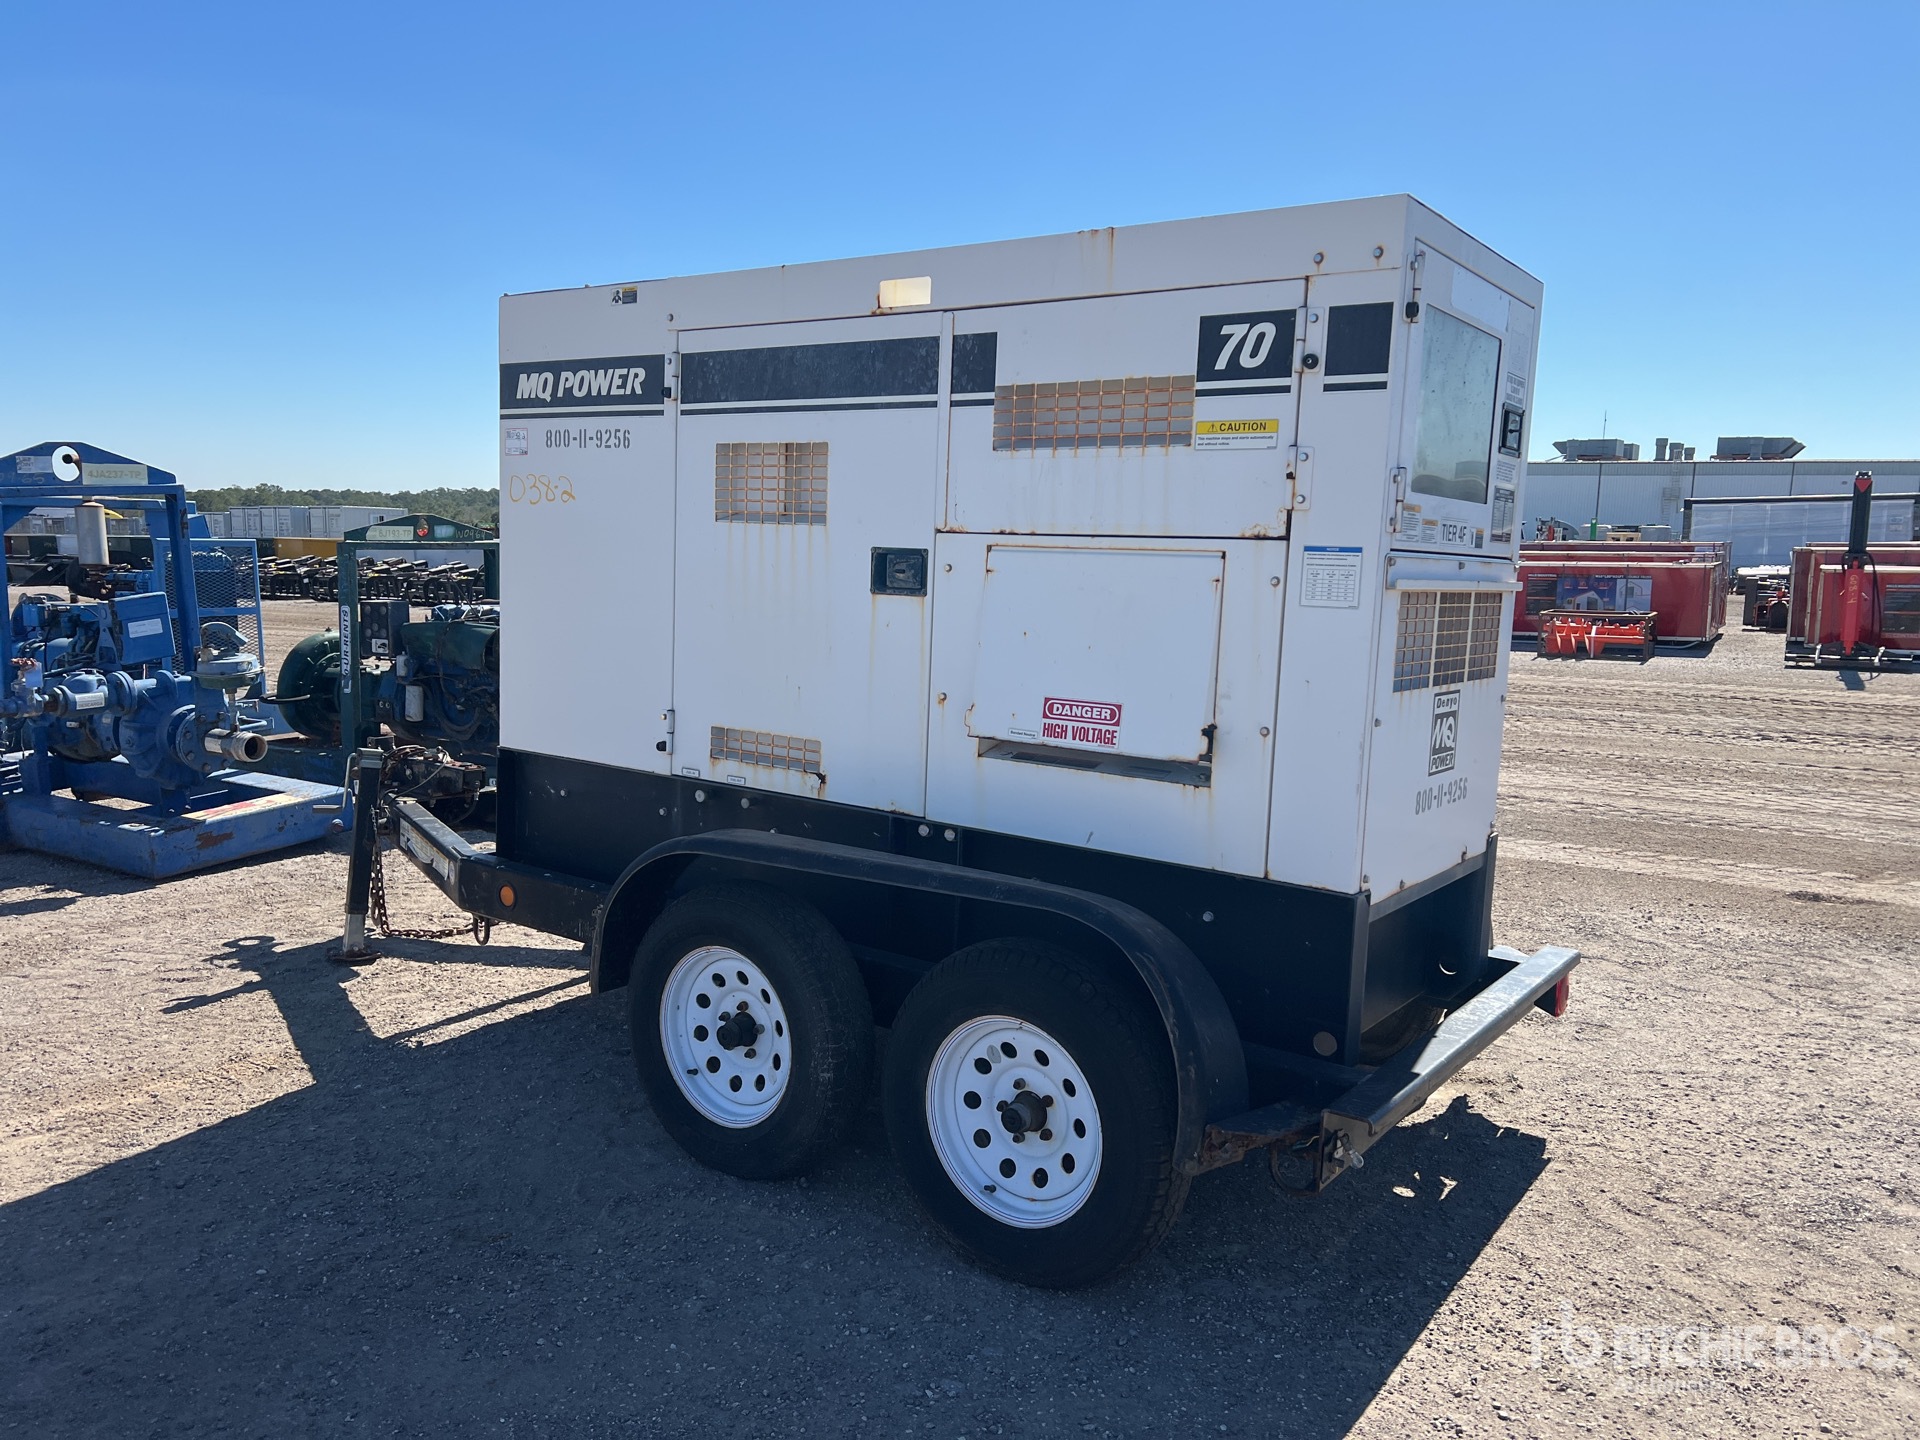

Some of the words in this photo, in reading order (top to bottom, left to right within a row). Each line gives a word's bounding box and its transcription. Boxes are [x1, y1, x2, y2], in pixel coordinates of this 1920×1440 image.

[1214, 322, 1277, 370] 70
[516, 371, 554, 403] MQ
[557, 367, 646, 398] POWER
[1219, 422, 1267, 432] CAUTION
[1442, 524, 1458, 542] TIER
[1053, 703, 1111, 720] DANGER
[1436, 696, 1458, 709] Denyo
[1042, 722, 1068, 740] HIGH
[1071, 725, 1118, 745] VOLTAGE
[1431, 716, 1455, 749] MQ
[1430, 752, 1454, 771] POWER
